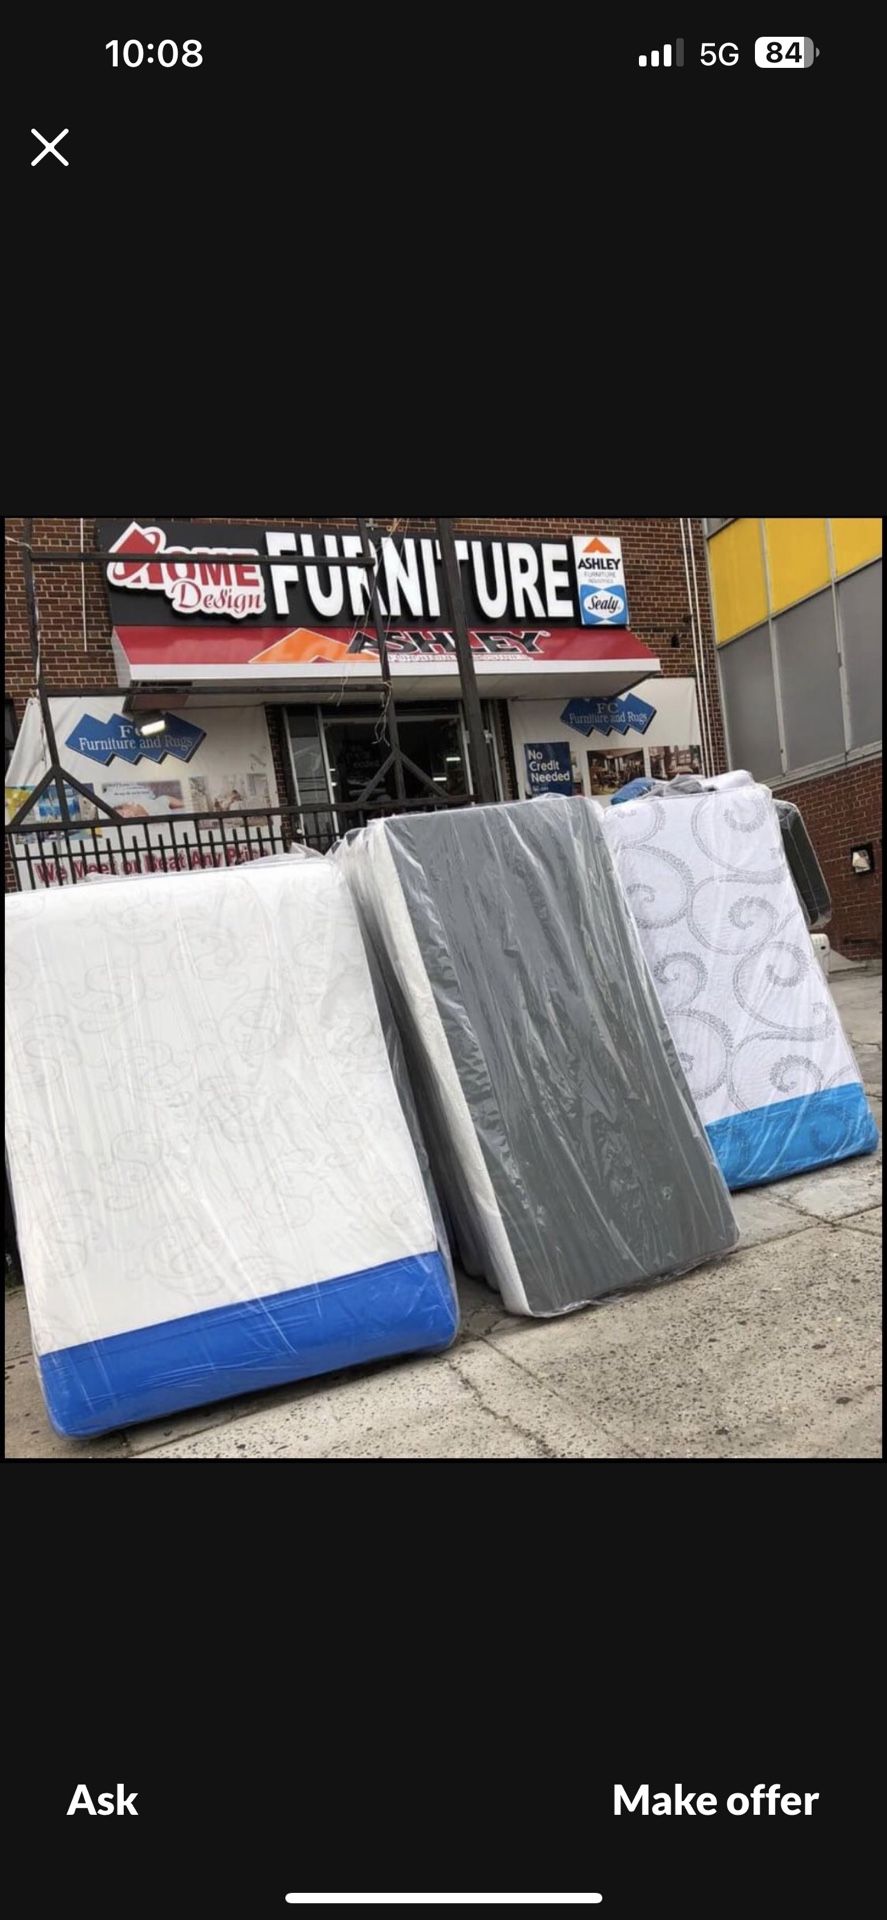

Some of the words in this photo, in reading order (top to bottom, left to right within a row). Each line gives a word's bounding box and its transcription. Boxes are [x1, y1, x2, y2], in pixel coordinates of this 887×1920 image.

[578, 557, 621, 570] ASHLEY
[265, 531, 574, 619] FURNIURE
[171, 580, 262, 614] Design
[587, 595, 620, 613] Sealy
[597, 703, 619, 714] FC
[569, 713, 609, 724] Furniture
[611, 712, 625, 723] and
[627, 711, 647, 725] Rugs
[79, 737, 136, 751] Furniture
[139, 737, 161, 749] and
[165, 735, 193, 752] Rugs
[528, 750, 543, 760] No
[529, 760, 560, 771] Credit
[531, 771, 570, 782] Needed
